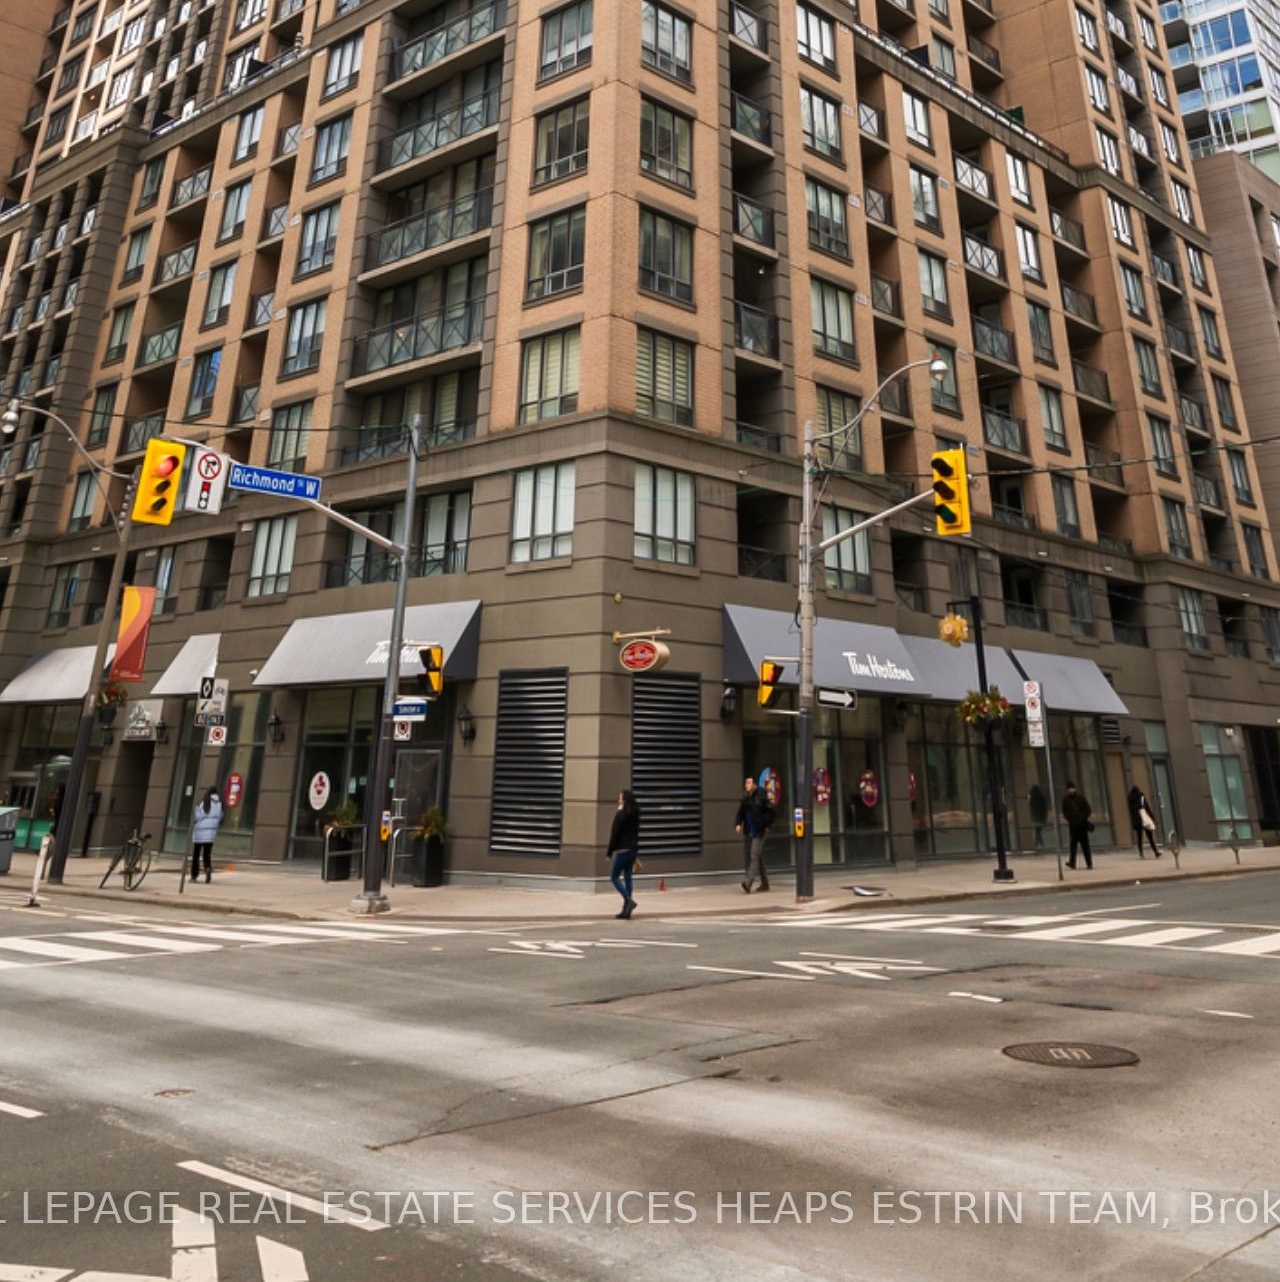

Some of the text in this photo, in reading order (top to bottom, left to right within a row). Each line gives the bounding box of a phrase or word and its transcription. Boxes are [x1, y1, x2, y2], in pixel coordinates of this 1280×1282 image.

[232, 468, 296, 492] Richmond
[305, 481, 318, 496] W
[842, 651, 915, 682] Tim Hortons
